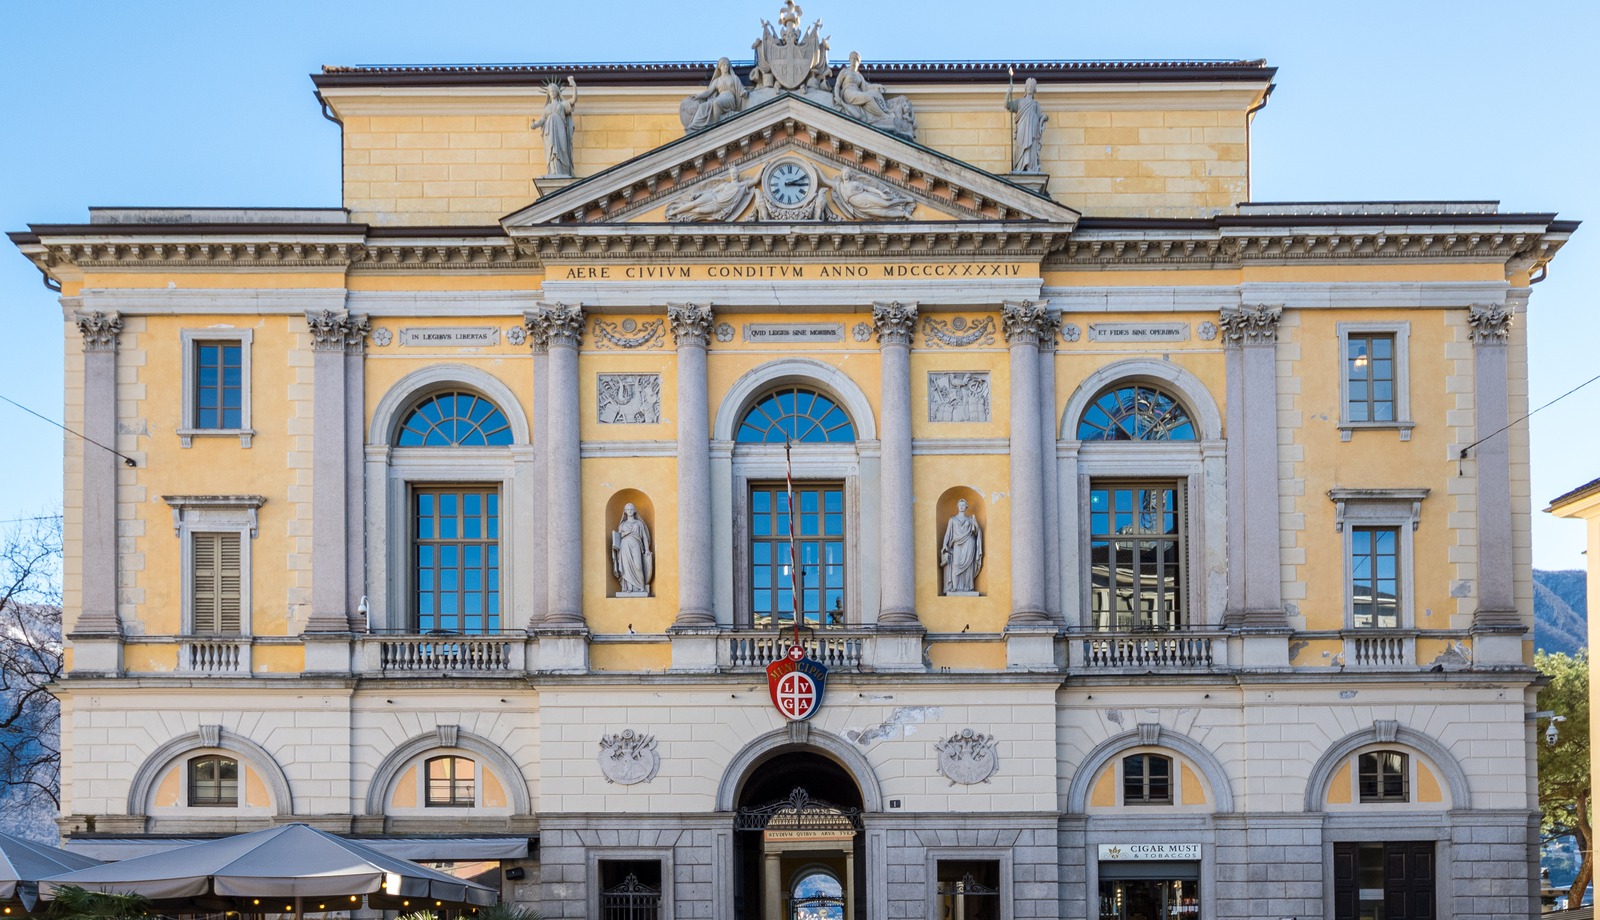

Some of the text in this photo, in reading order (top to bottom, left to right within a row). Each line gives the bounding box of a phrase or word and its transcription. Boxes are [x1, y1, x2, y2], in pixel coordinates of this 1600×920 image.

[566, 265, 1021, 279] AERE CIVIVM CONDITVM ANNO MDCCCXXXXIV
[751, 329, 766, 337] QVID
[770, 661, 825, 681] MUNICIPIO
[1168, 844, 1199, 852] MUST
